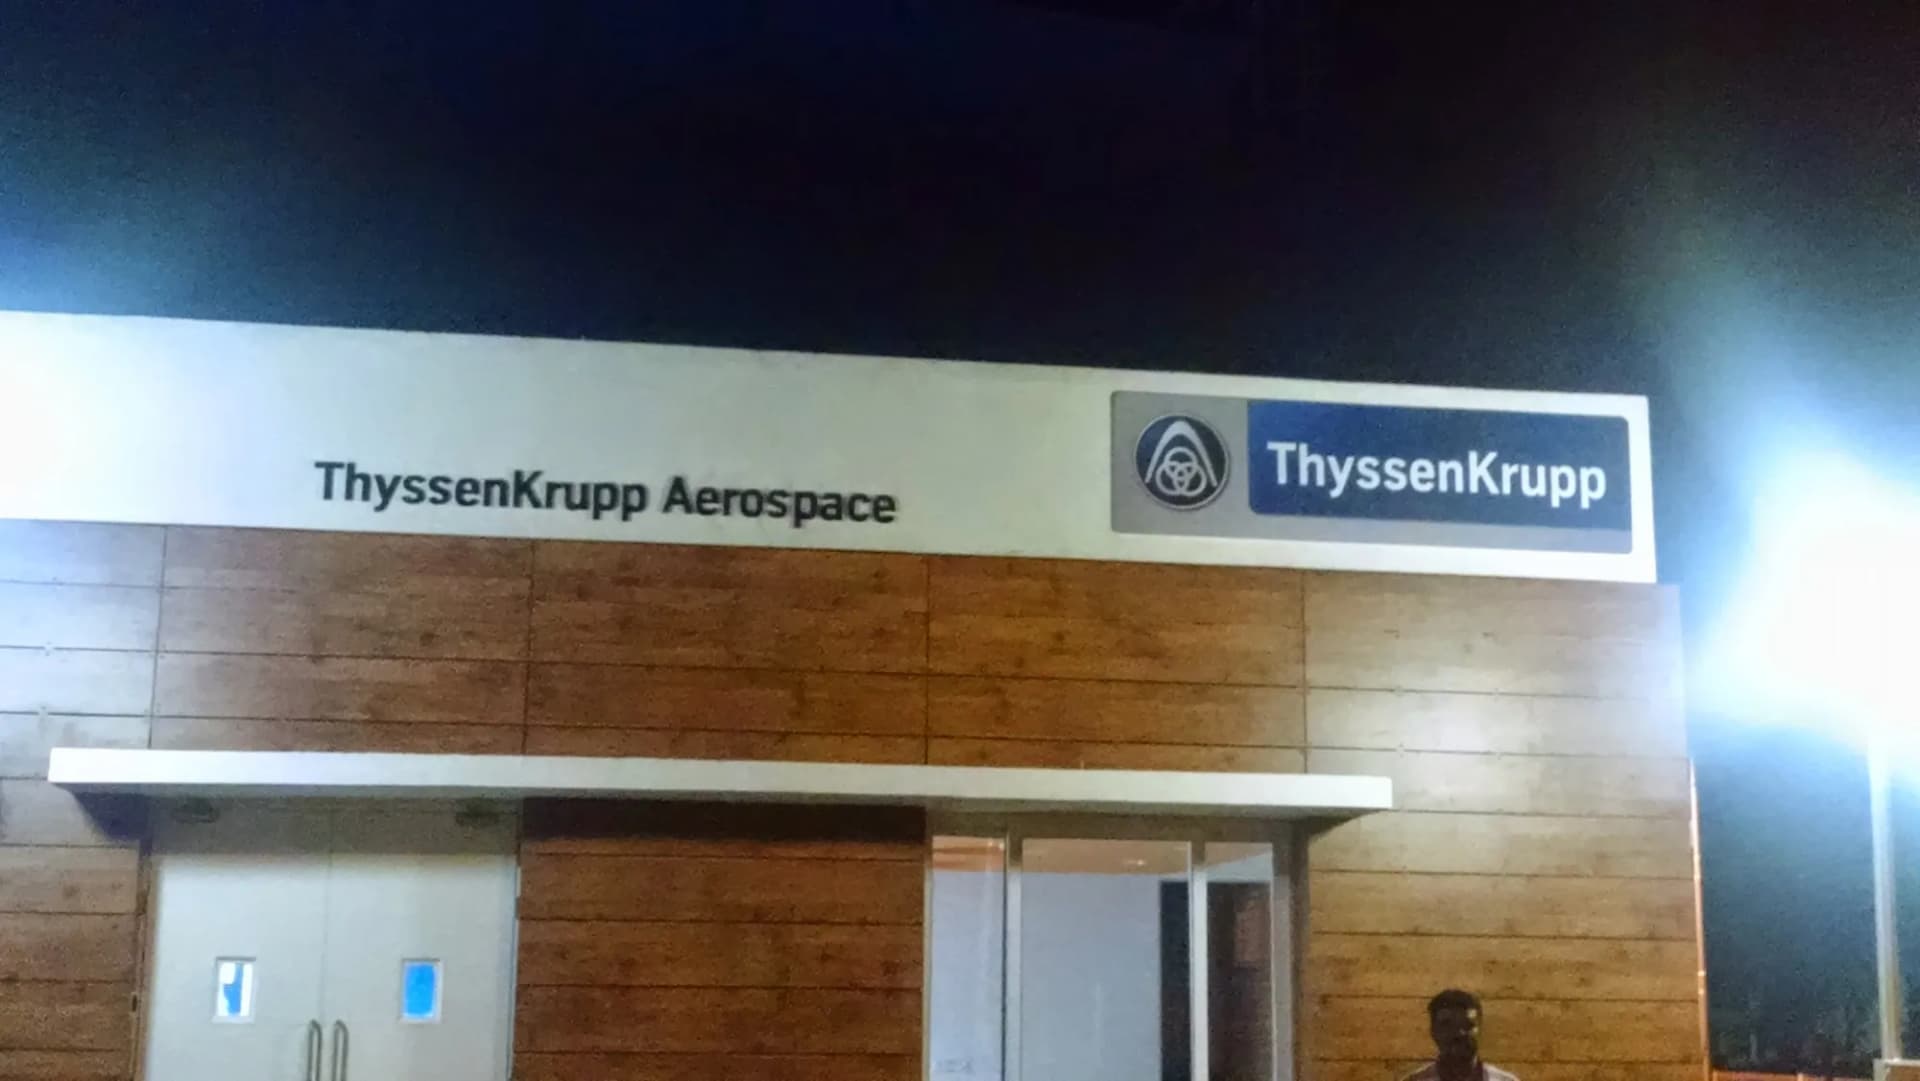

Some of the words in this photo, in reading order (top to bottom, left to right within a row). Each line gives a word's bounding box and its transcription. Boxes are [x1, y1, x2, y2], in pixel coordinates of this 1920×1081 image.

[314, 461, 648, 520] ThyssenKrupp
[663, 475, 897, 528] Aerospace
[1267, 441, 1606, 508] ThyssenKrupp
